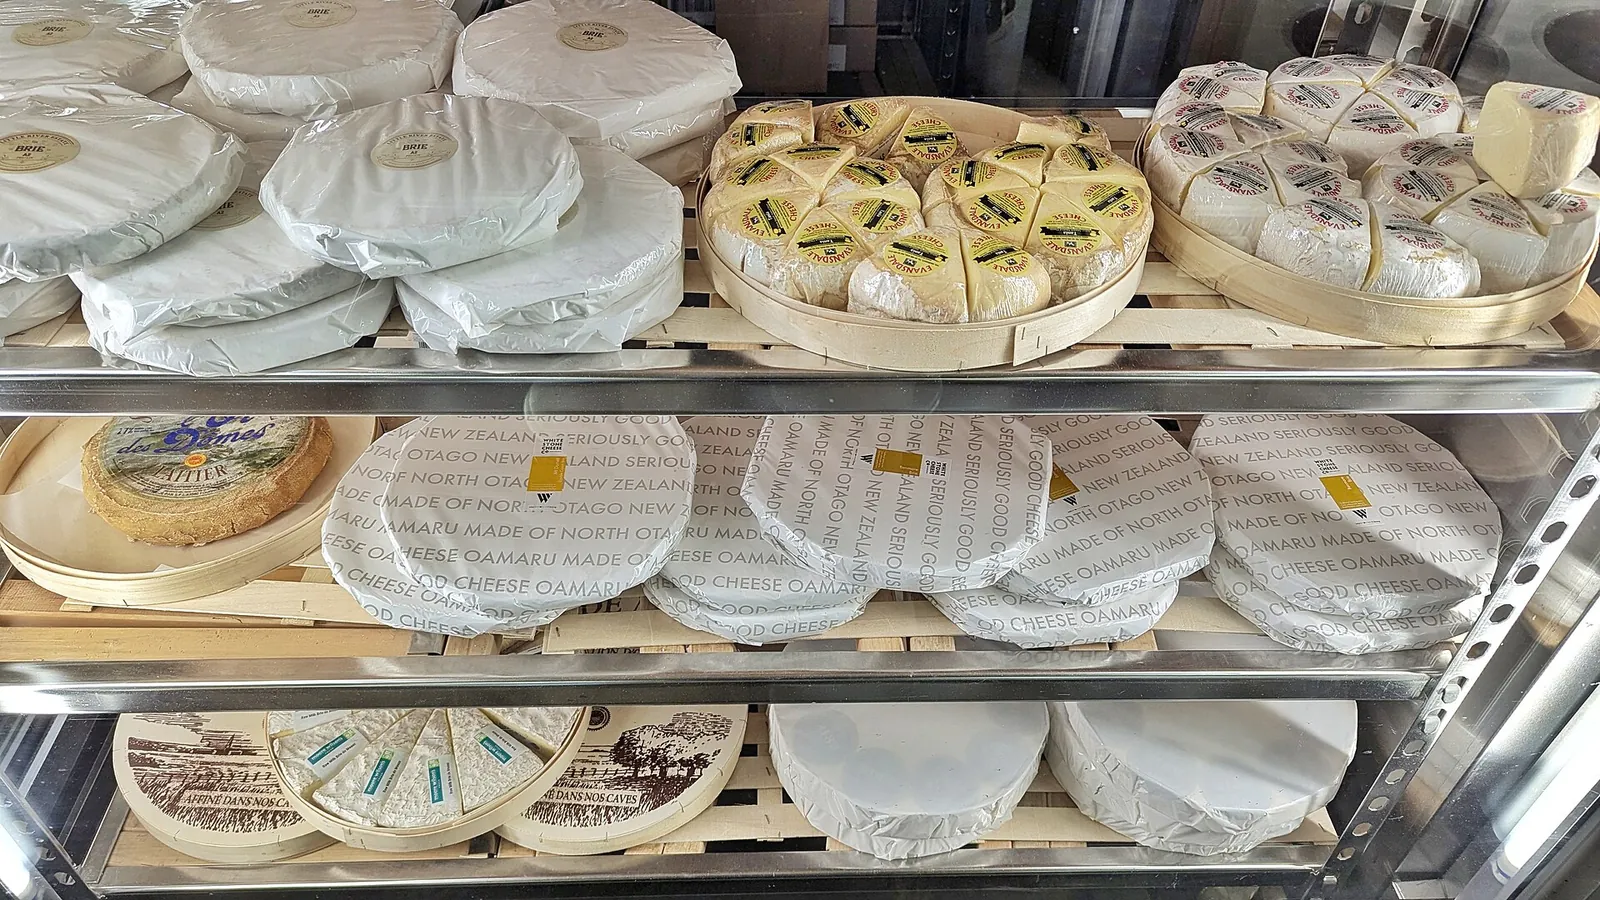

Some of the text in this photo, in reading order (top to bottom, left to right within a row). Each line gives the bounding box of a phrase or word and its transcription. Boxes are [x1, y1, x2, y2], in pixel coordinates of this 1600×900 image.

[581, 30, 605, 38] BRIE
[911, 118, 942, 129] CHEESE
[402, 143, 429, 151] BRIE
[912, 145, 954, 161] EVANSDALE
[780, 199, 798, 222] CHEESE
[1003, 192, 1027, 211] CHEESE
[1053, 213, 1088, 223] CHEESE
[1304, 204, 1346, 230] EVANSDALE
[805, 222, 838, 234] CHEESE
[911, 235, 944, 248] CHEESE
[1045, 240, 1096, 256] EVANSDALE
[806, 246, 854, 264] EVANSDALE
[887, 254, 933, 274] EVANSDALE
[419, 427, 461, 441] NEW
[1115, 416, 1153, 434] GOO
[117, 437, 152, 454] des
[753, 417, 775, 462] CHEESE
[1111, 431, 1175, 460] SERIOUS
[1193, 425, 1414, 448] ZEALAND SERIOUSLY GOOD
[407, 448, 530, 466] OTAGO NEW
[1199, 442, 1411, 468] NEW ZEALAND SERIOUSLY
[410, 472, 479, 488] NORTH
[563, 478, 608, 490] NEW
[766, 421, 803, 520] OAMARU MADE
[794, 420, 835, 526] MADE OF NORTH
[1082, 474, 1121, 495] NEW
[1121, 451, 1191, 482] ZEALAND
[1211, 470, 1277, 487] OTAGO
[991, 426, 1014, 538] SERIOUSLY GOOD
[828, 473, 852, 524] OTAGO
[861, 479, 883, 514] NEW
[1025, 449, 1044, 546] GOOD CHEESE
[1097, 489, 1155, 516] OTAGO
[1153, 474, 1193, 497] NEW
[1232, 490, 1297, 508] NORTH
[1366, 483, 1410, 496] NEW
[1412, 480, 1485, 493] ZEALAN
[380, 495, 676, 515] MADE OF NEW
[694, 505, 719, 517] OF
[923, 478, 947, 550] SERIOUSLY
[955, 453, 982, 573] SERIOUSLY GOOD
[1227, 502, 1489, 532] MADE OF OTAGO NEW
[463, 524, 673, 541] MADE OF NORTH OTA
[1053, 506, 1184, 561] MADE OF NORTH
[1233, 523, 1472, 561] OAMARU MADE OF NORTH
[463, 550, 622, 567] OAMARU MADE
[851, 514, 876, 585] ZEALAND
[1076, 529, 1201, 581] OAMARU MADE
[1270, 547, 1485, 581] CHEESE OAMARU MADE
[347, 567, 419, 599] CHEESE
[454, 576, 530, 595] CHEESE
[712, 575, 783, 593] CHEESE
[1090, 575, 1149, 606] CHEESE
[1353, 578, 1425, 598] CHEESE
[399, 613, 478, 636] CHEESE
[1010, 601, 1161, 633] CHEESE OAMARU
[1351, 615, 1421, 635] CHEESE
[185, 793, 275, 807] AFFINÉ DANS NOS
[555, 789, 638, 806] DANS NOS CAVES
